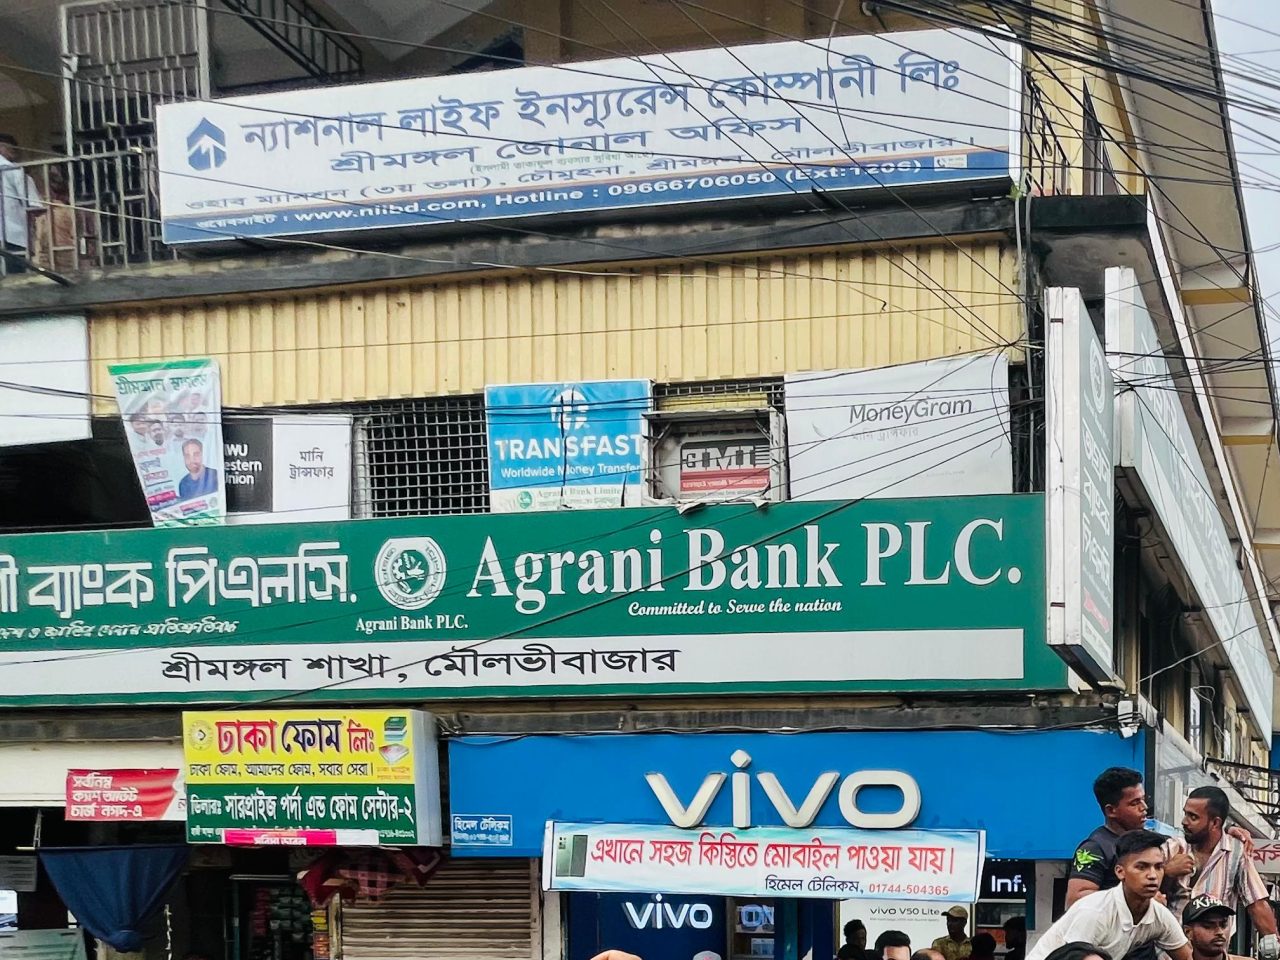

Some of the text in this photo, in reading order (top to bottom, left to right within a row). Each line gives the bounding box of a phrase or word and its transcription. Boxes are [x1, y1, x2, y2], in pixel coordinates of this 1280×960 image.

[240, 111, 387, 152] ন্যাশনাল
[397, 95, 502, 136] লাইফ
[708, 54, 876, 109] কোম্পানী
[894, 51, 960, 93] লিঃ
[329, 117, 805, 173] শ্রীমঙ্গল জোনাল অফিস
[495, 189, 584, 206] Hotline
[607, 172, 777, 196] 09666706050
[849, 398, 973, 424] MoneyGram
[299, 447, 324, 462] মানি
[494, 434, 641, 461] TRANSFAST
[224, 459, 262, 471] estern
[225, 471, 255, 485] nion
[501, 462, 641, 478] Worldwide Money Transfer
[466, 529, 665, 615] Agrani
[682, 524, 843, 592] Bank
[860, 518, 1022, 587] PLC.
[27, 562, 154, 619] ব্যাংক
[165, 541, 357, 609] পিএলসি.
[628, 598, 843, 617] Committed to Serve the nation
[355, 614, 468, 635] Agrani Bank PLC.
[162, 644, 682, 683] শ্রীমঙ্গল শাখা, মৌলভীবাজার
[215, 718, 375, 754] ঢাকা ফোম লিঃ
[189, 763, 212, 777] ঢাকা
[245, 763, 285, 776] আমাদের
[318, 763, 343, 776] সবার
[643, 749, 923, 829] vivo
[224, 787, 278, 823] সারপ্রাইজ
[280, 786, 303, 821] পর্দা
[329, 794, 358, 820] ফোম
[454, 816, 479, 831] হিমেল
[590, 838, 644, 866] এখানে
[648, 840, 693, 867] সহজ
[699, 832, 759, 870] কিস্তিতে
[763, 837, 841, 872] মোবাইল
[847, 845, 903, 874] পাওয়া
[765, 875, 803, 893] হিমেল
[868, 882, 950, 896] 01744-504365
[991, 874, 1027, 893] Inf
[621, 893, 714, 930] vivo
[870, 906, 940, 916] vivo V50 Lite
